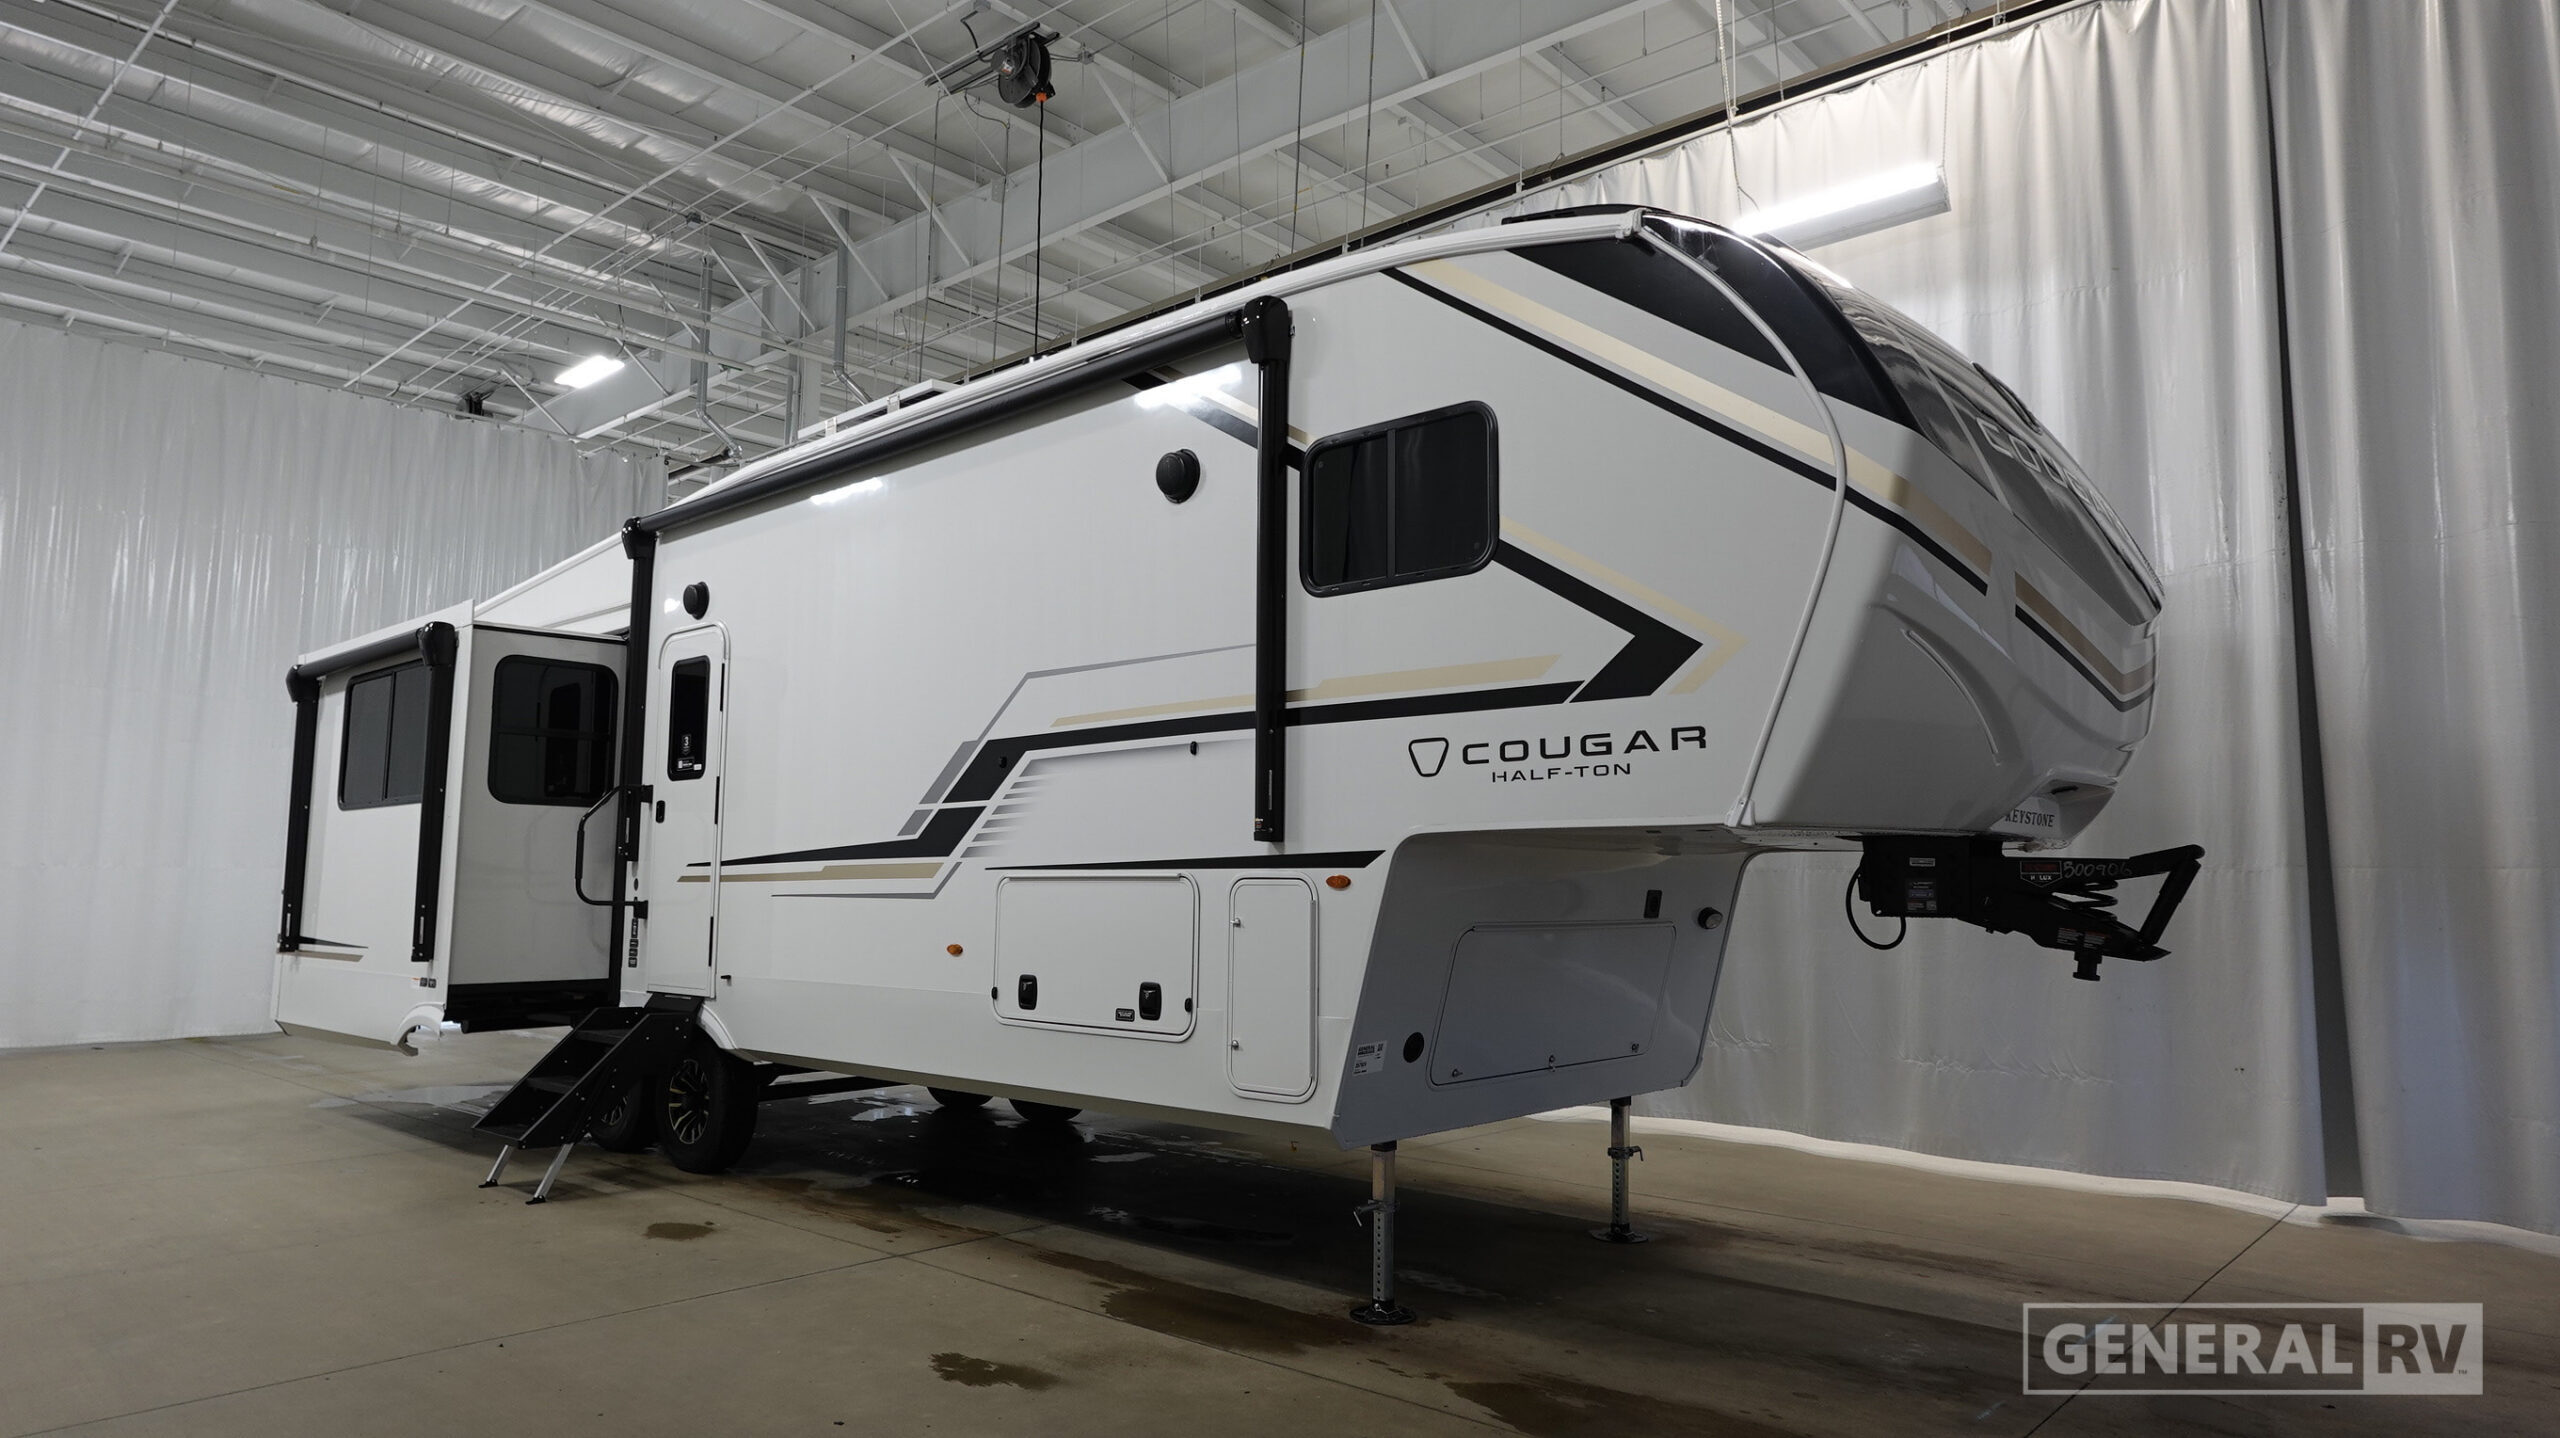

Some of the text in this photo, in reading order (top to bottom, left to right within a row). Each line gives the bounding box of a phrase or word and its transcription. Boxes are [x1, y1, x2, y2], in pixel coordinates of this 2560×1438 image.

[1462, 725, 1707, 764] COUGAR
[1492, 763, 1632, 783] HALF-TON
[2005, 809, 2055, 828] KEYSTONE
